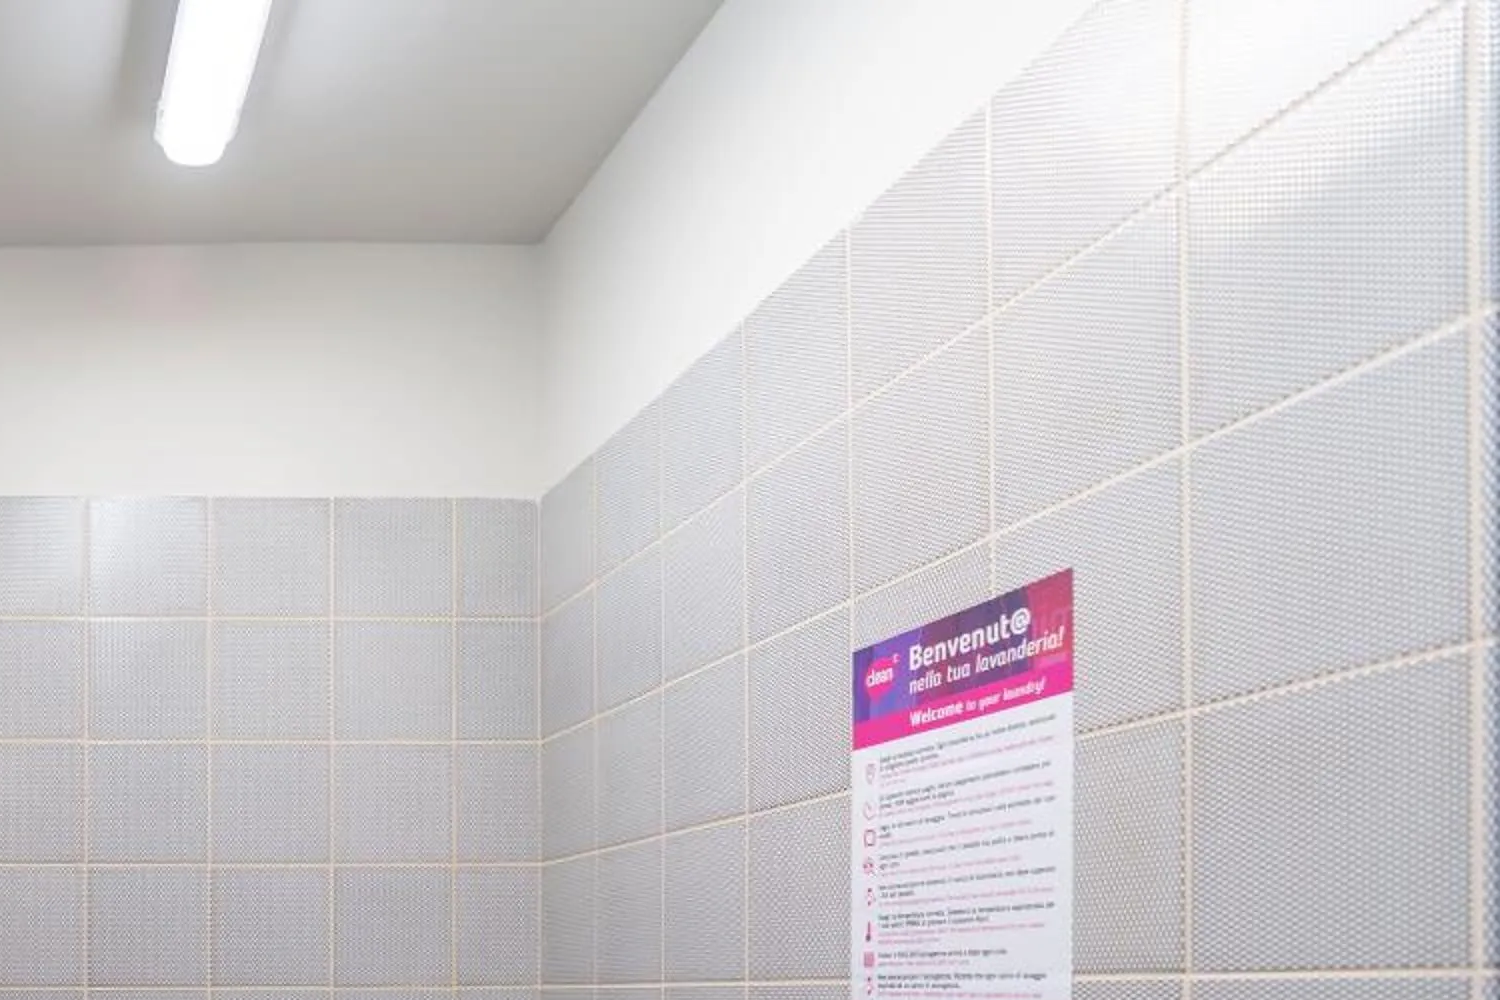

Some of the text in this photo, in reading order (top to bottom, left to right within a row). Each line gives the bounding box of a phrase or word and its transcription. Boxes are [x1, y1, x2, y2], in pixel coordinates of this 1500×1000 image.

[909, 608, 1031, 671] Benvenut@
[910, 626, 1065, 694] nella tua lavanderia!
[909, 699, 964, 726] Welcome
